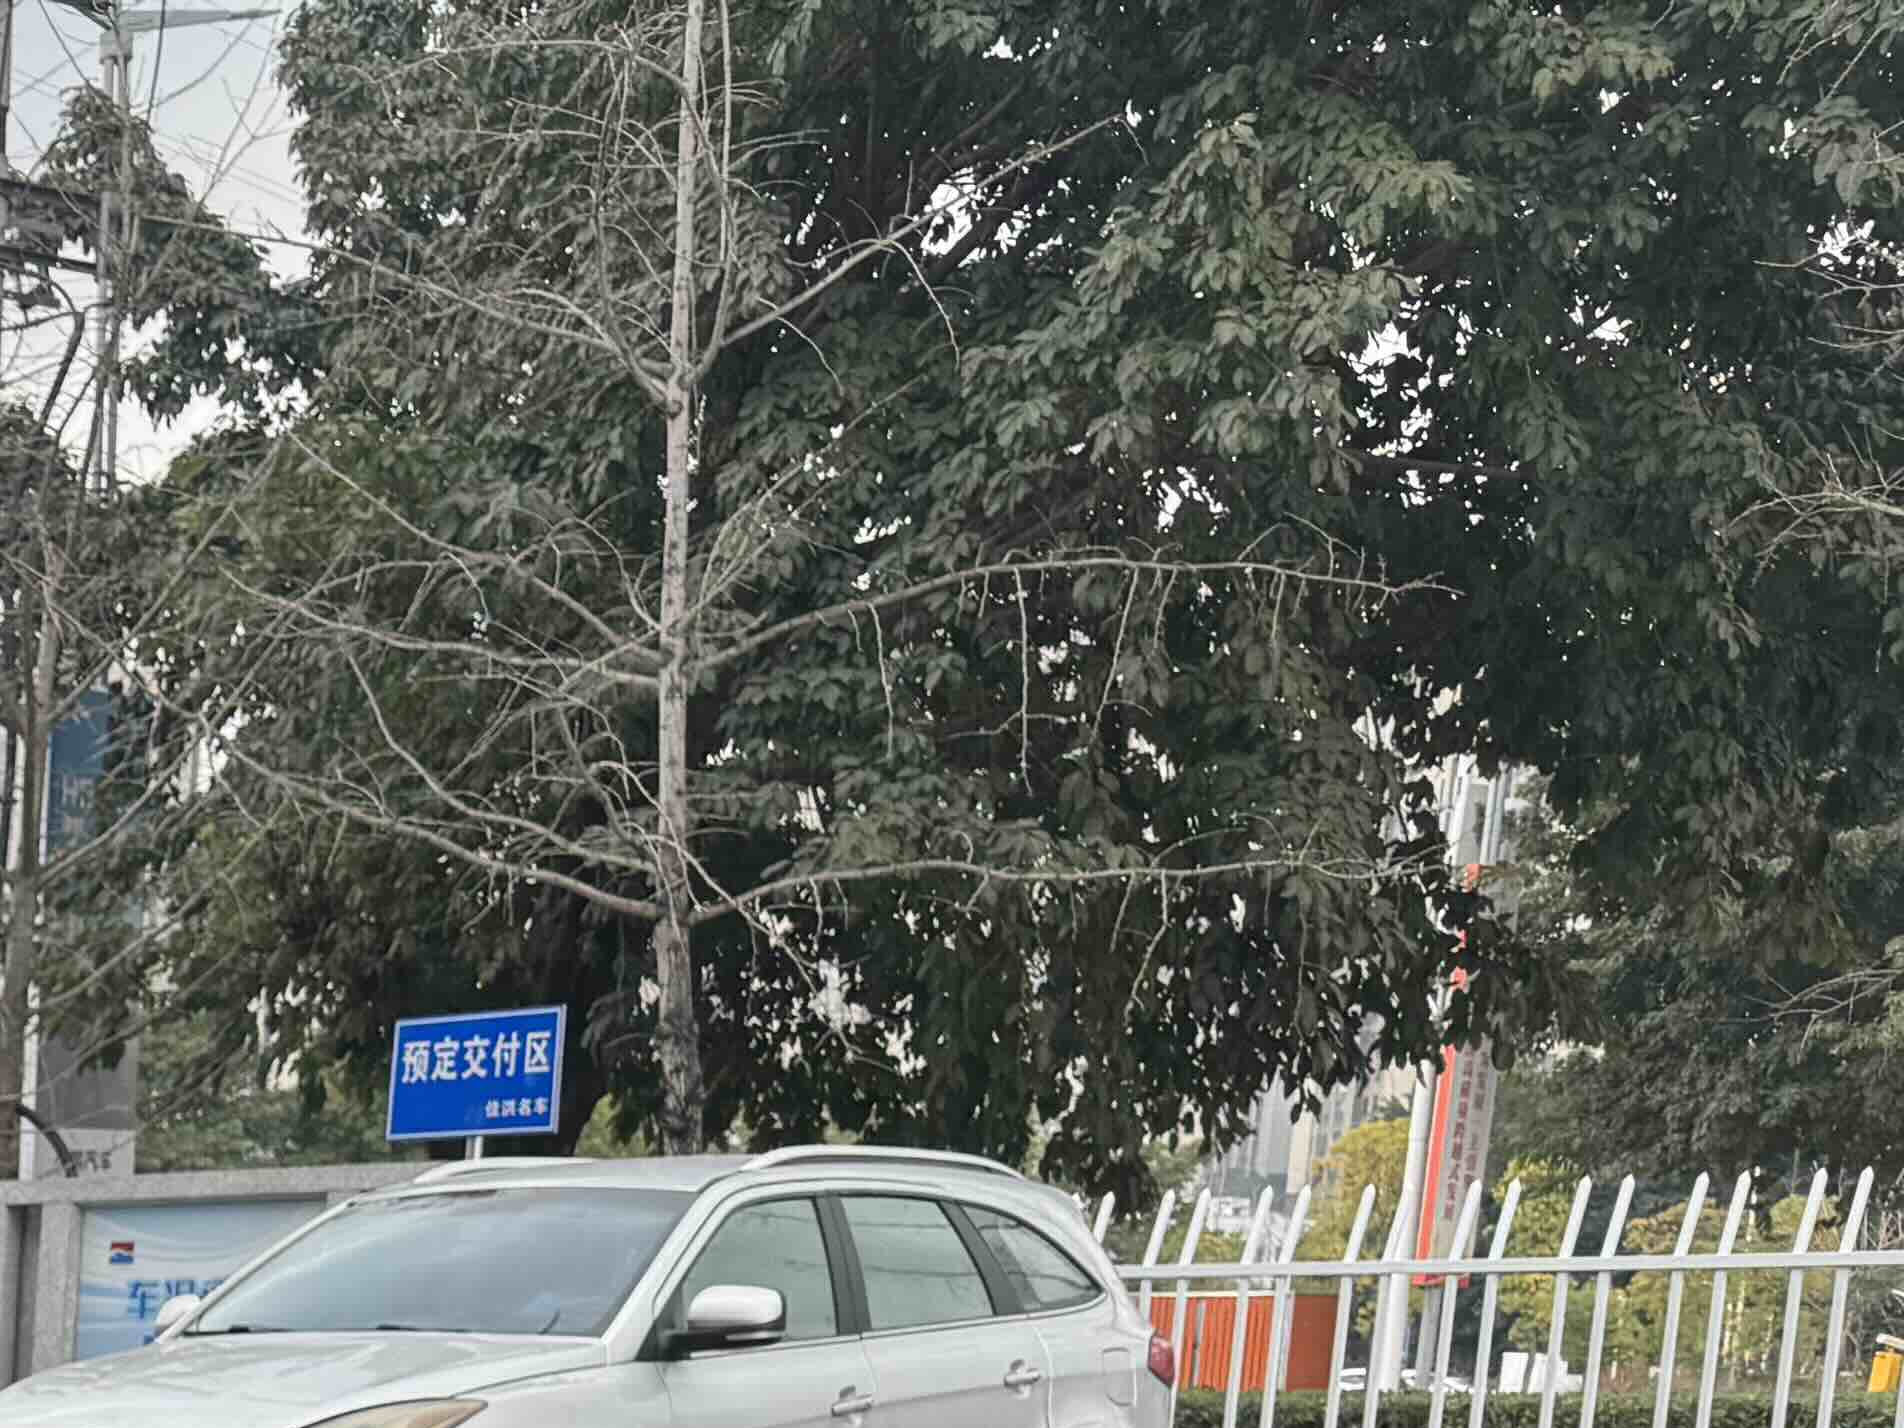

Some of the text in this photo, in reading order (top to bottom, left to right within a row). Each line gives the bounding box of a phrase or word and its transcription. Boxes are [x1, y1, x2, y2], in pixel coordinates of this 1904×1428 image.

[402, 1031, 551, 1084] 预定交付区
